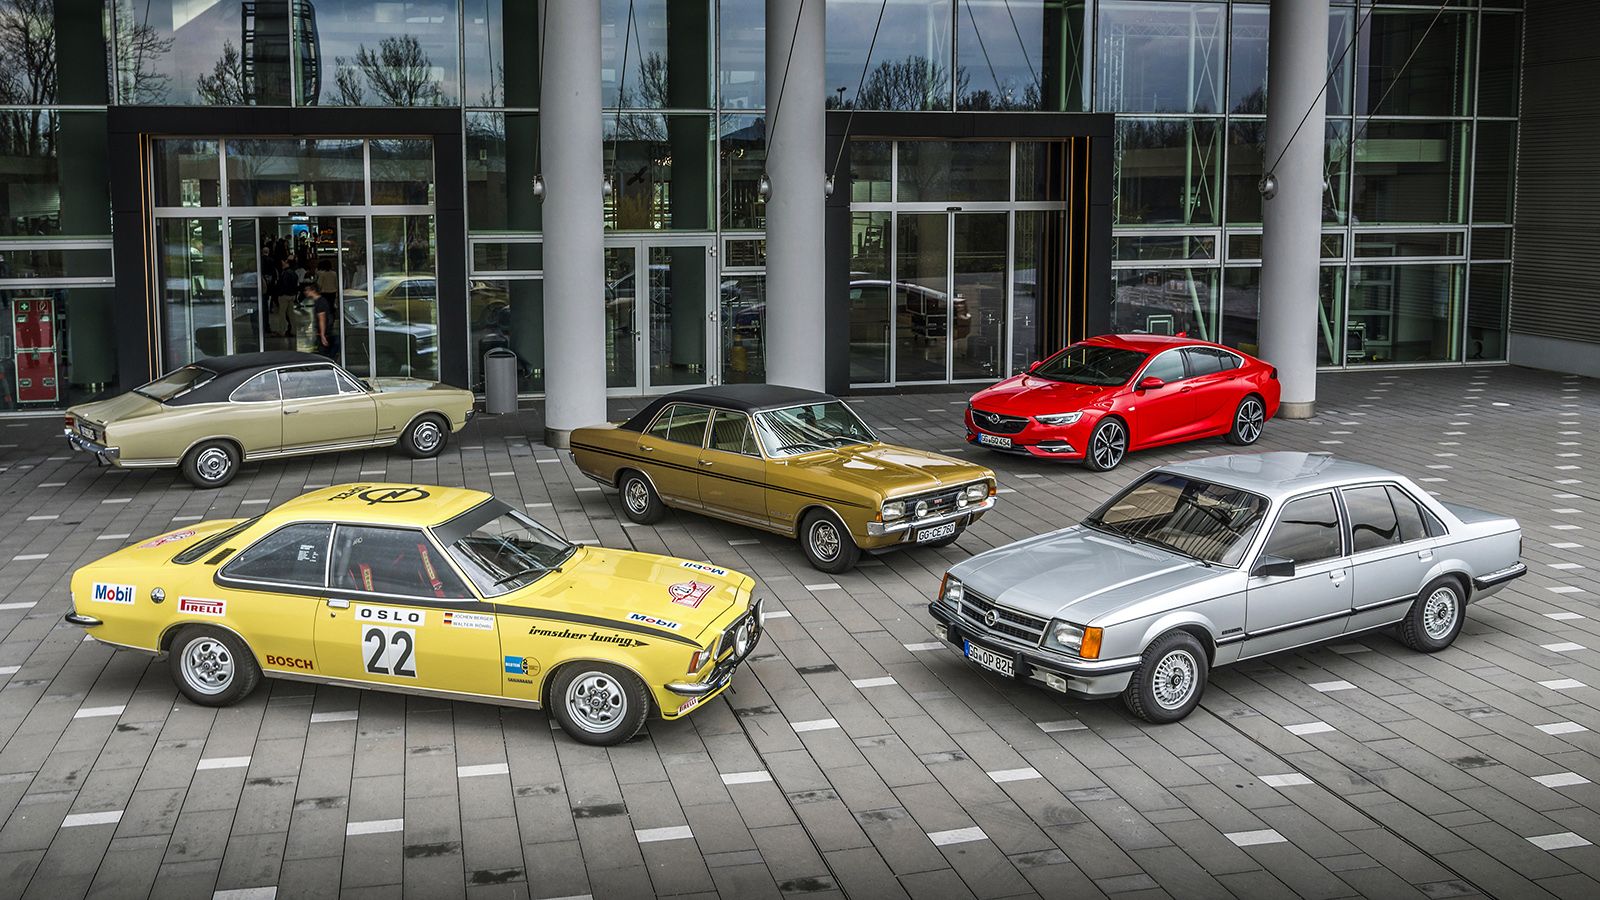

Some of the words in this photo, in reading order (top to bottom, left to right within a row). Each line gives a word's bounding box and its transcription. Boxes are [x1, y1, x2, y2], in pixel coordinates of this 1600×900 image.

[684, 562, 725, 576] Mobil
[95, 584, 132, 602] Mobil
[180, 599, 224, 614] PIRELLI
[360, 608, 420, 622] OSLO
[631, 613, 677, 629] Mobil
[364, 627, 416, 678] 22
[969, 644, 978, 659] GG
[983, 651, 994, 666] OP
[995, 657, 1014, 676] 82H
[266, 655, 314, 670] BOSCH
